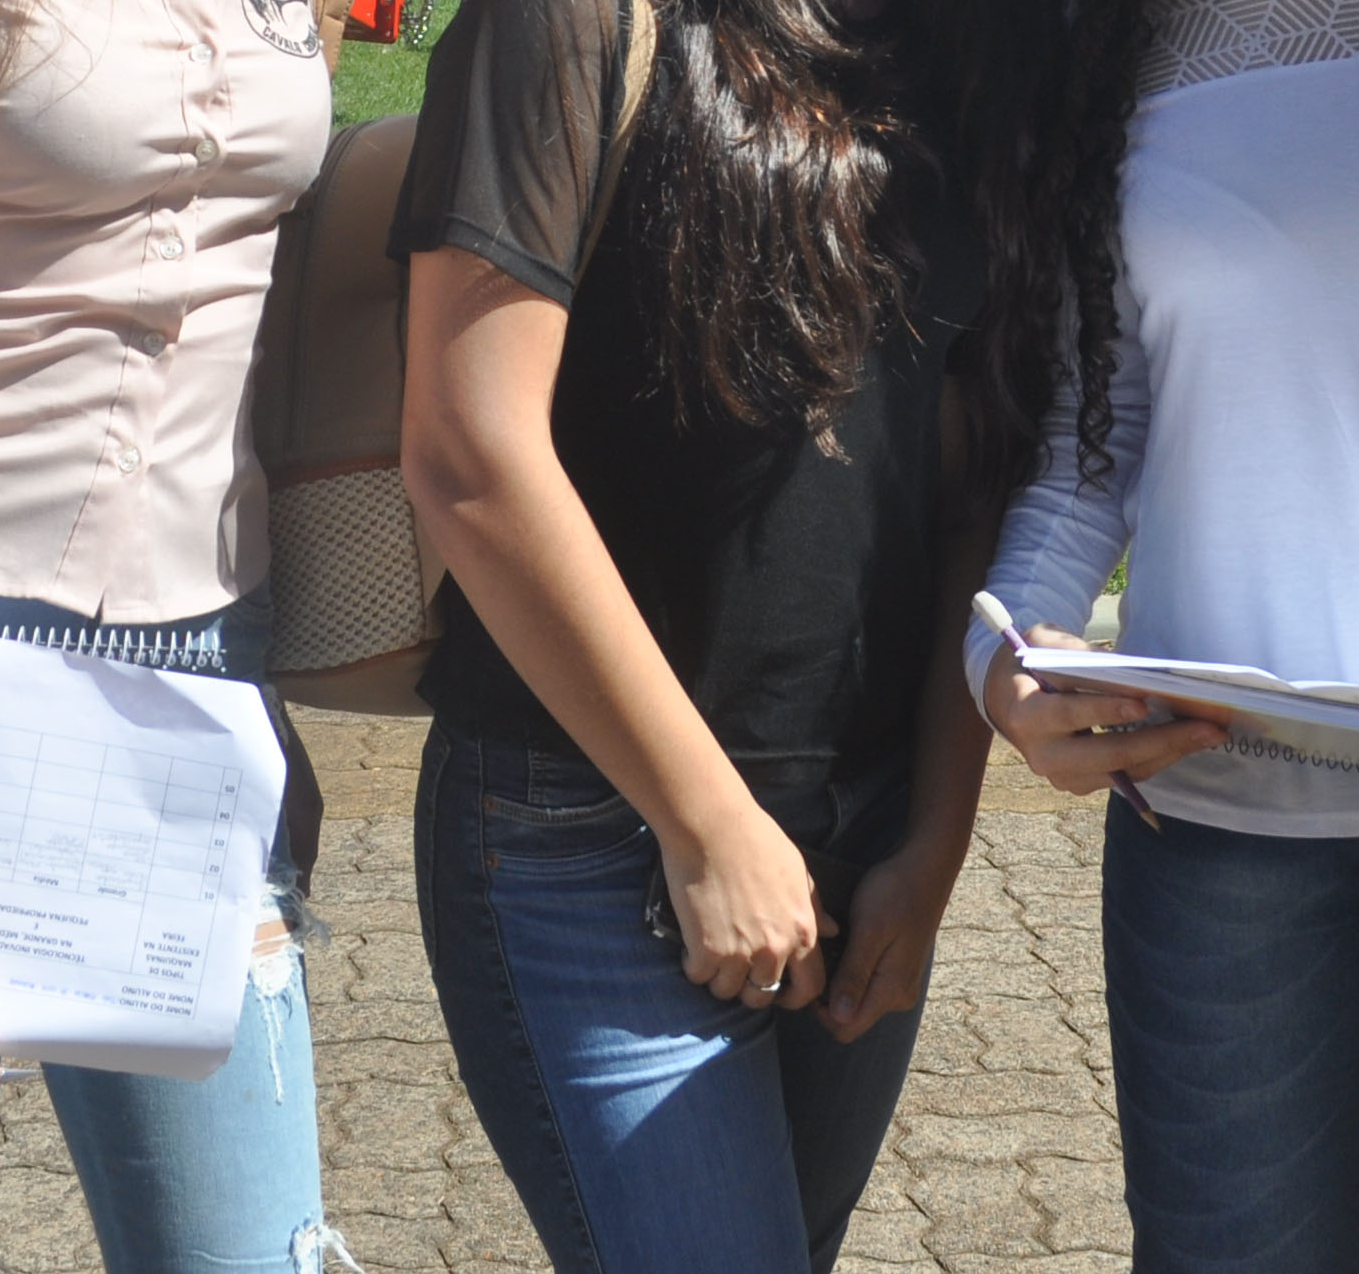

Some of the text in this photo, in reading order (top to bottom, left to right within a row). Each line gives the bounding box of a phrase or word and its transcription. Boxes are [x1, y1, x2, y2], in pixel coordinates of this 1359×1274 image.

[148, 967, 160, 975] DE
[152, 991, 166, 1000] DO
[168, 993, 194, 1005] NOME
[150, 1003, 163, 1012] DO
[166, 1005, 191, 1016] NOME
